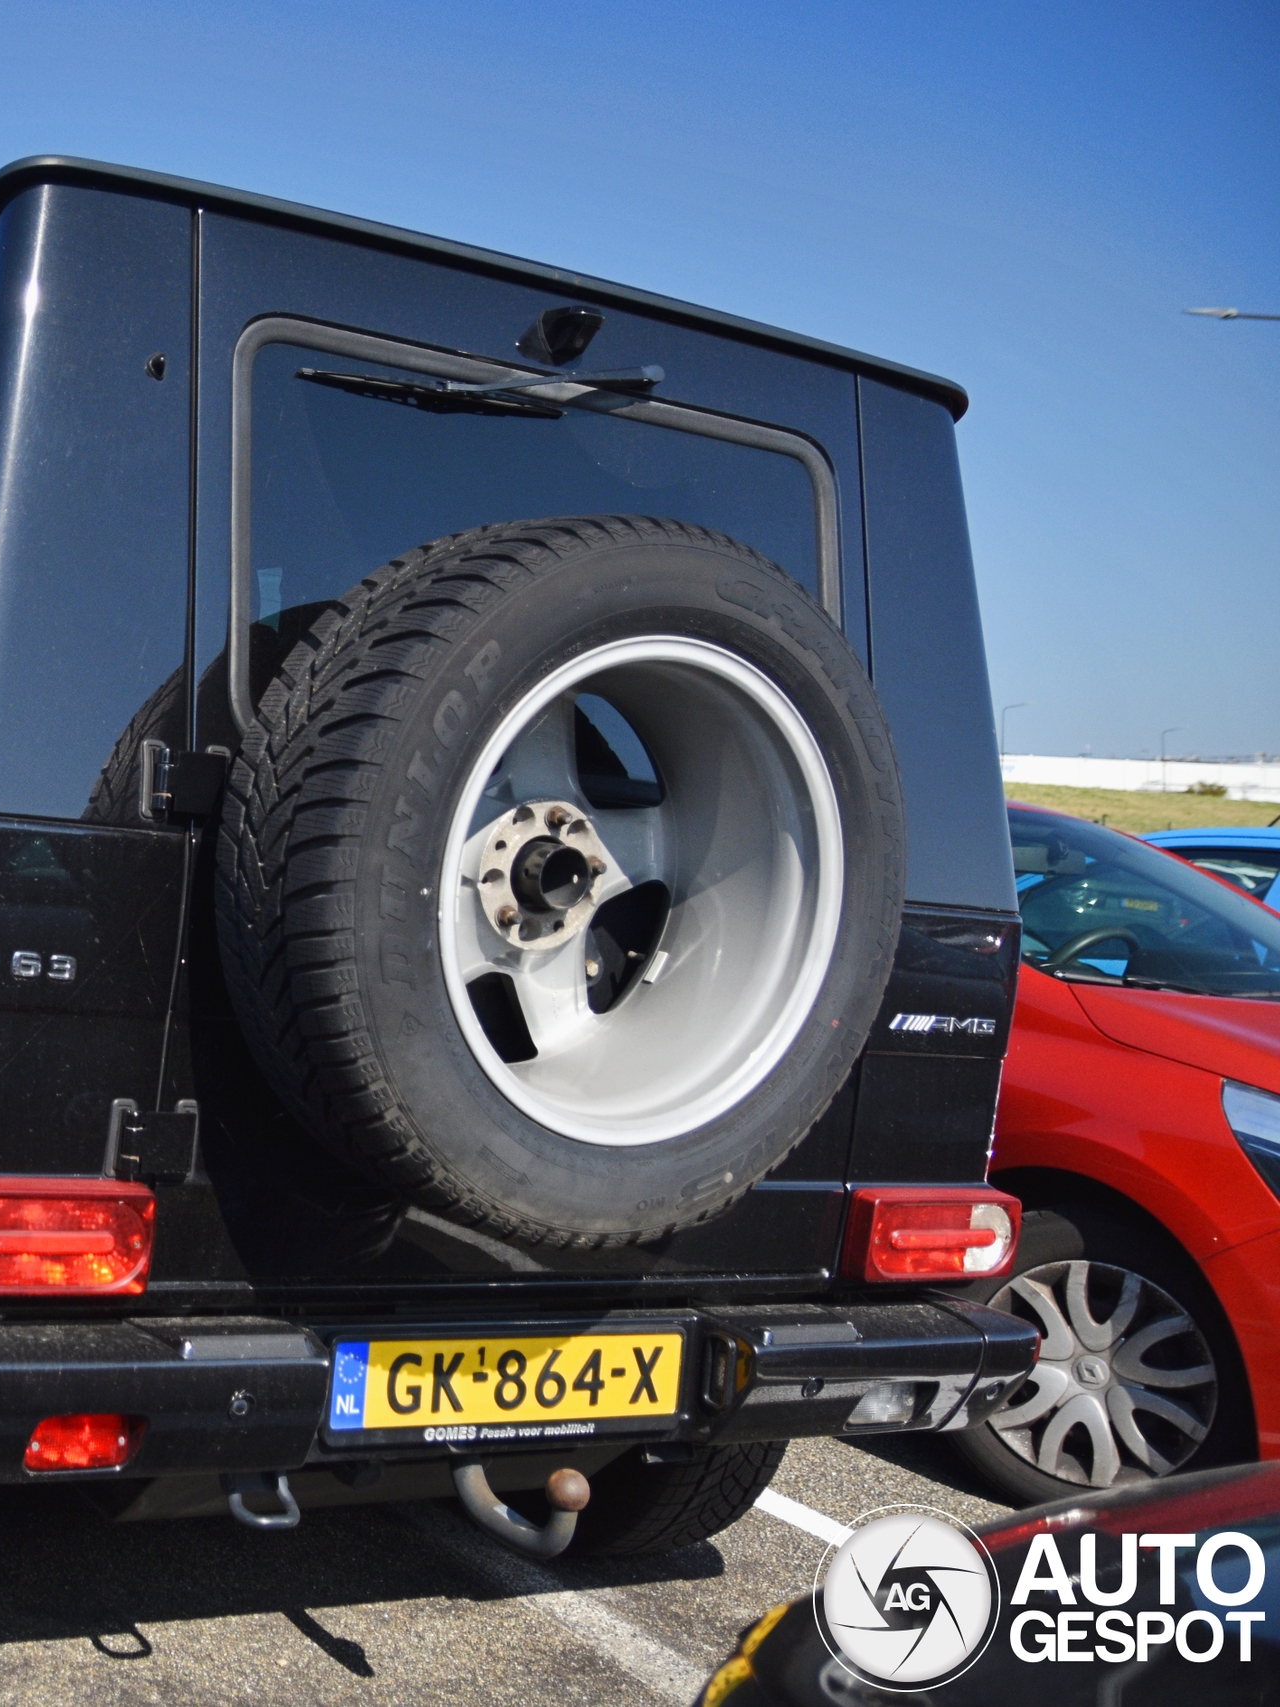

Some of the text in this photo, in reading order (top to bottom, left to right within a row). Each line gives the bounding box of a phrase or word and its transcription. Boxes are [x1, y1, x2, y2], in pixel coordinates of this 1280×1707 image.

[379, 638, 503, 989] DUNLOP
[386, 1345, 664, 1416] GK-864-X
[335, 1394, 360, 1416] NL
[424, 1422, 596, 1442] GOMES Passie voor mobiliteit
